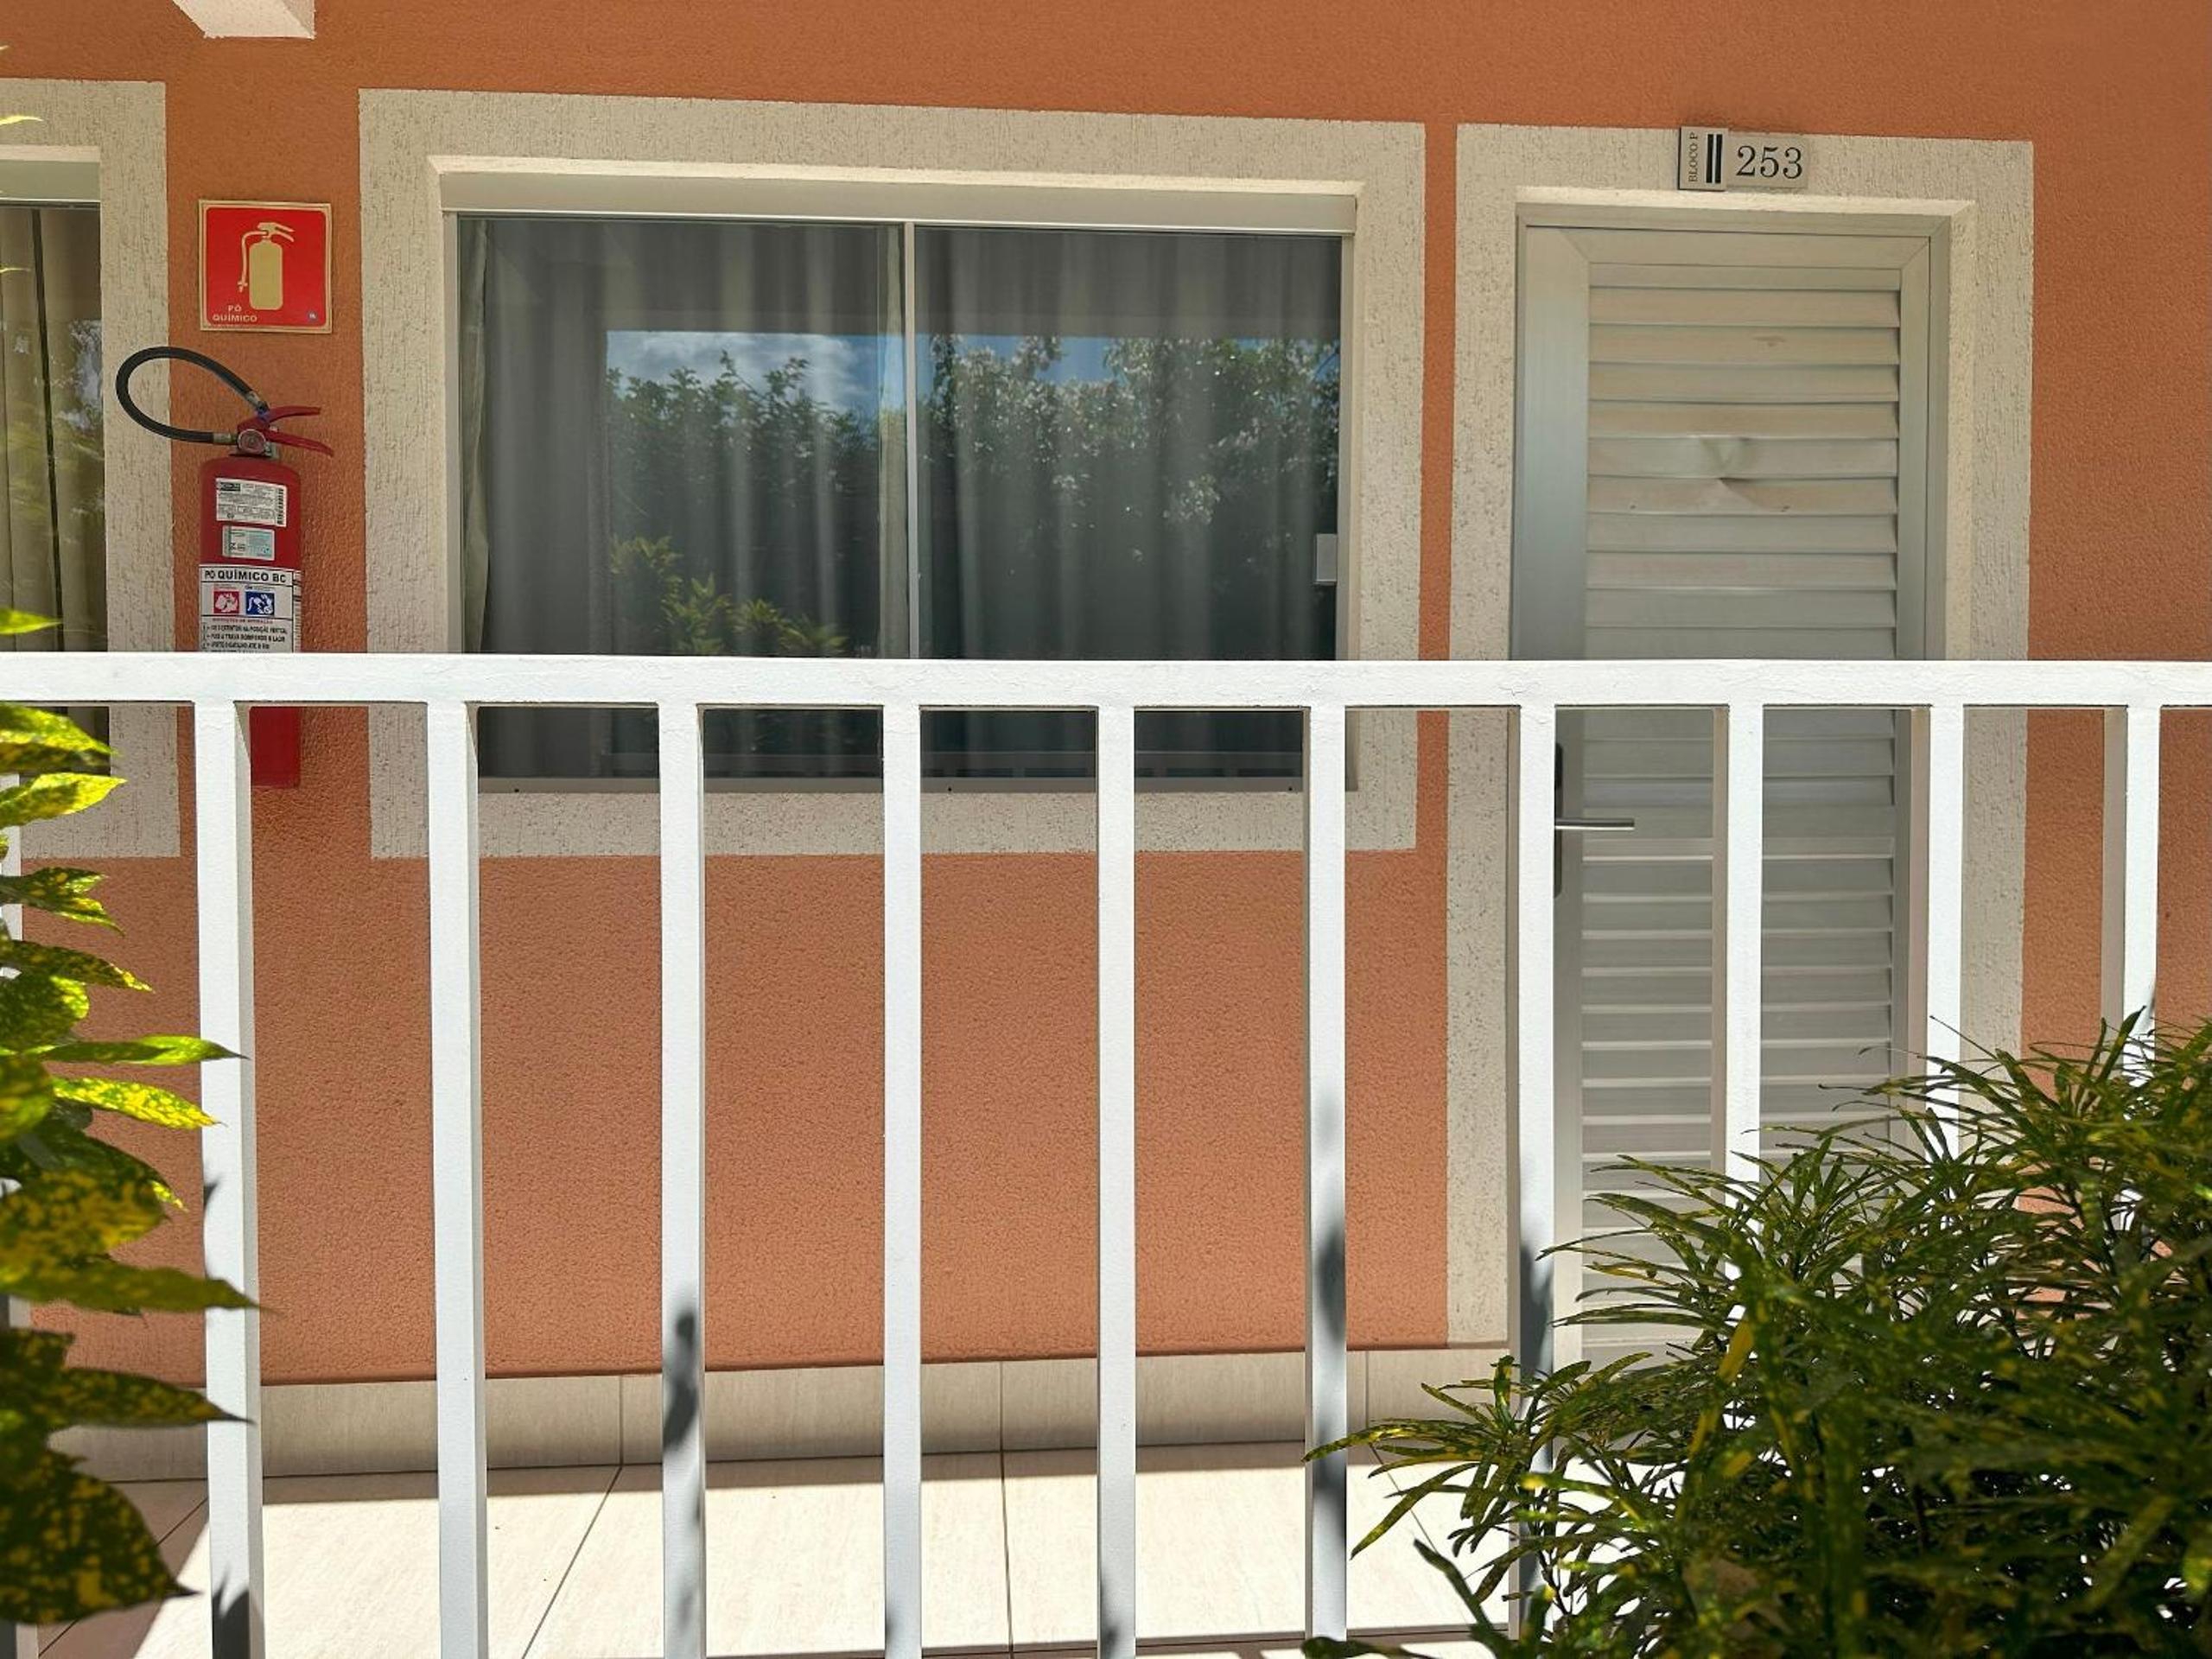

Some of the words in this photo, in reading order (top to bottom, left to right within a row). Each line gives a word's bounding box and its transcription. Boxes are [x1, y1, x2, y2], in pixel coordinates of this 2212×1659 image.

[1690, 131, 1699, 140] P
[1688, 143, 1699, 182] BLOCO
[1735, 144, 1803, 180] 253
[212, 313, 257, 322] QUÍMICO
[218, 569, 270, 582] QUÍMICO
[272, 573, 287, 583] BC
